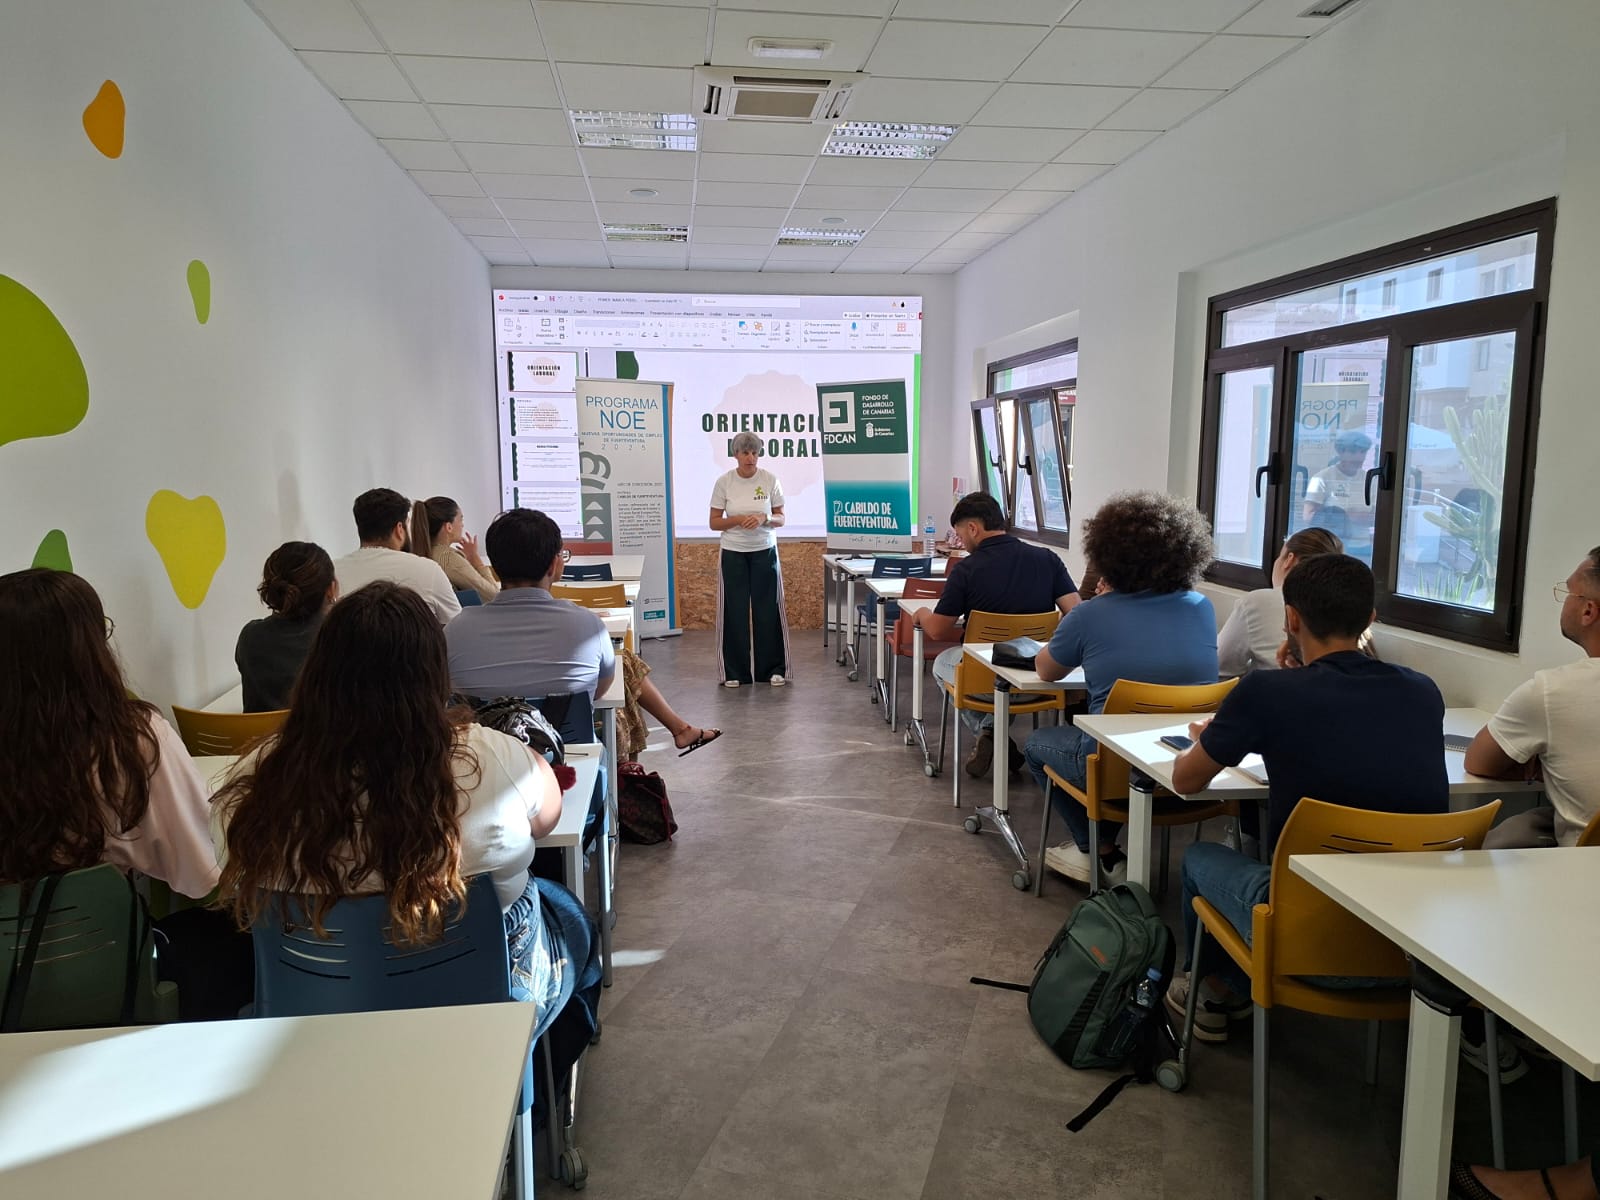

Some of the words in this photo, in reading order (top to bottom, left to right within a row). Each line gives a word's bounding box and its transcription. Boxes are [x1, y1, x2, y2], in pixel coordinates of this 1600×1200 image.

[585, 395, 658, 409] PROGRAMA
[600, 409, 646, 430] NOE
[823, 433, 857, 444] FDCAN
[844, 501, 880, 515] CABILDO
[881, 502, 892, 515] DE
[833, 516, 898, 529] FUERTEVENTURA
